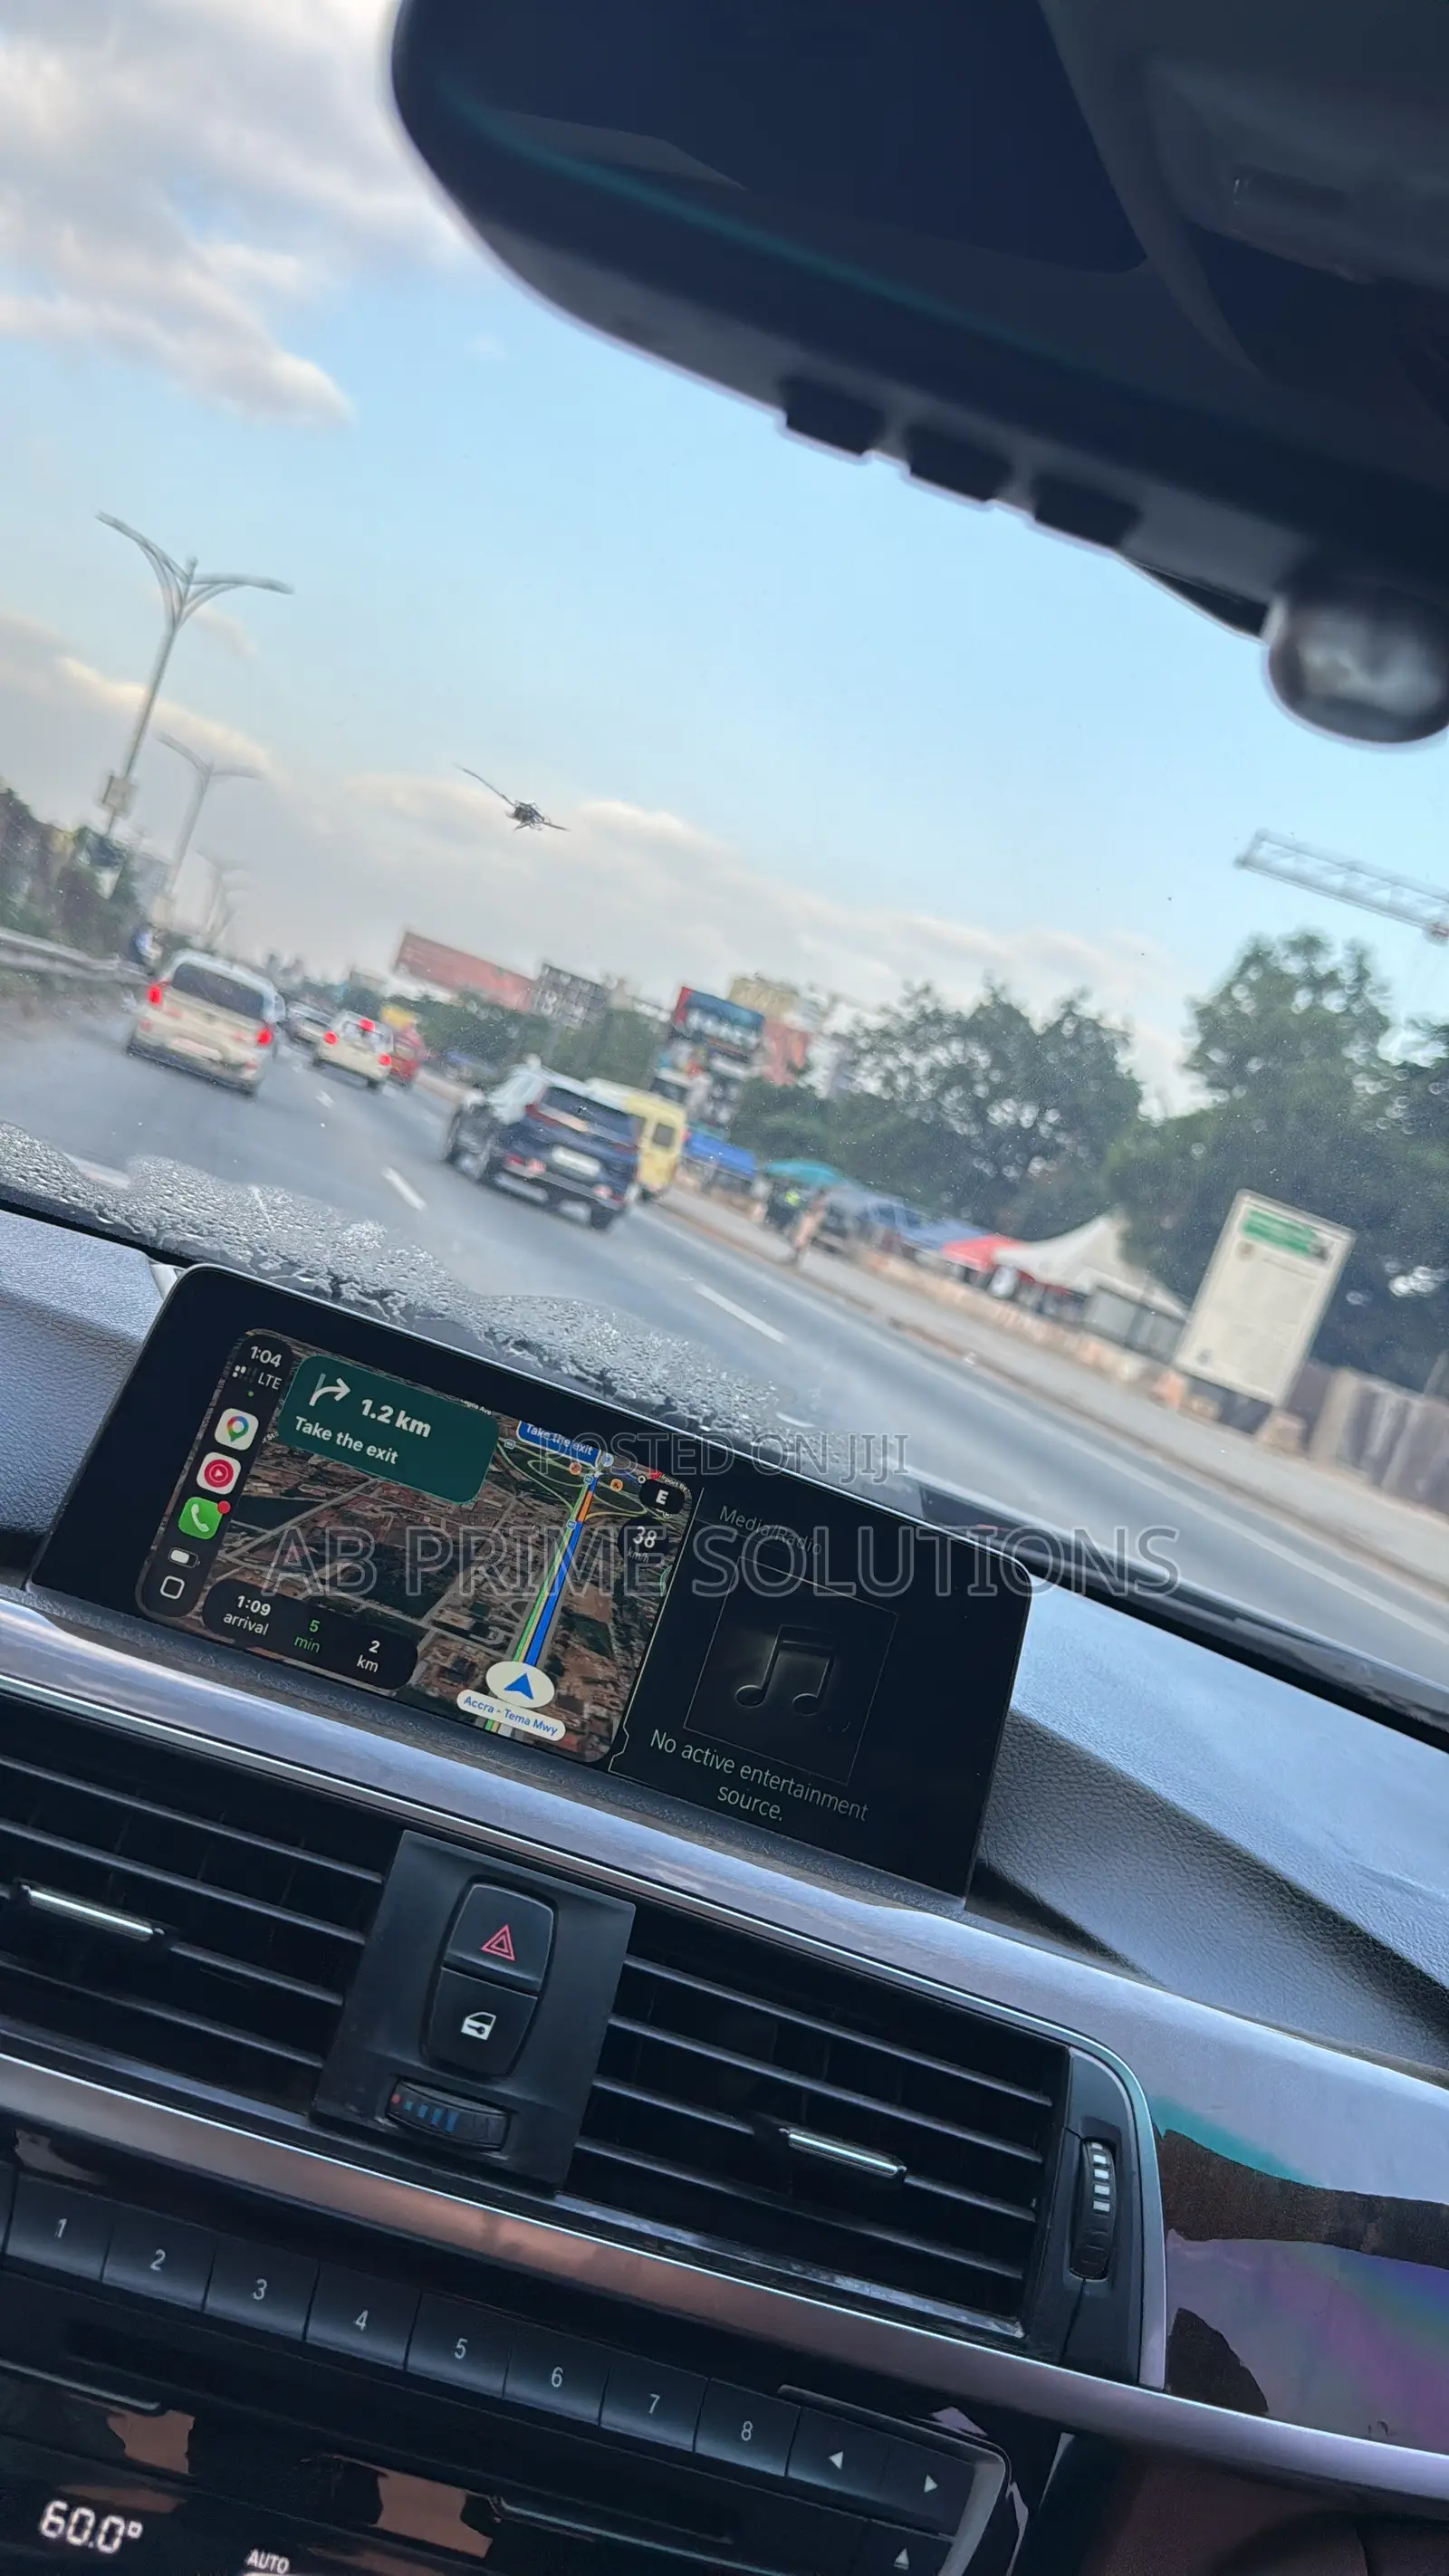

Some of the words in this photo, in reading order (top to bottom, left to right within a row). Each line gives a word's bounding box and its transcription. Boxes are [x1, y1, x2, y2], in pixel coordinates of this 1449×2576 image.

[249, 1345, 283, 1368] 1:04
[257, 1372, 283, 1391] LTE
[361, 1399, 394, 1424] 1.2
[395, 1410, 432, 1438] km
[294, 1416, 332, 1441] Take
[336, 1431, 364, 1452] the
[366, 1443, 398, 1465] exit
[525, 1422, 549, 1441] Take
[552, 1432, 571, 1449] the
[572, 1438, 594, 1456] exit
[659, 1473, 679, 1489] irport
[656, 1489, 669, 1505] E
[632, 1525, 657, 1548] 38
[719, 1505, 822, 1555] Media/Radio
[627, 1547, 650, 1565] km/h
[235, 1594, 272, 1617] 1:09
[223, 1611, 270, 1636] arrival
[308, 1619, 321, 1634] 5
[293, 1633, 321, 1654] min
[369, 1639, 380, 1654] 2
[356, 1654, 379, 1674] km
[463, 1695, 494, 1715] Accra
[504, 1708, 532, 1728] Tema
[533, 1717, 559, 1738] Mwy
[650, 1728, 677, 1756] No
[681, 1740, 735, 1776] active
[740, 1757, 869, 1822] entertainment
[717, 1784, 784, 1823] source.
[54, 2217, 68, 2239] 1
[150, 2248, 167, 2272] 2
[253, 2278, 268, 2301] 3
[355, 2310, 369, 2331] 4
[454, 2338, 468, 2360] 5
[551, 2366, 564, 2389] 6
[648, 2393, 661, 2415] 7
[741, 2419, 753, 2442] 8
[245, 2548, 291, 2574] AUTO
